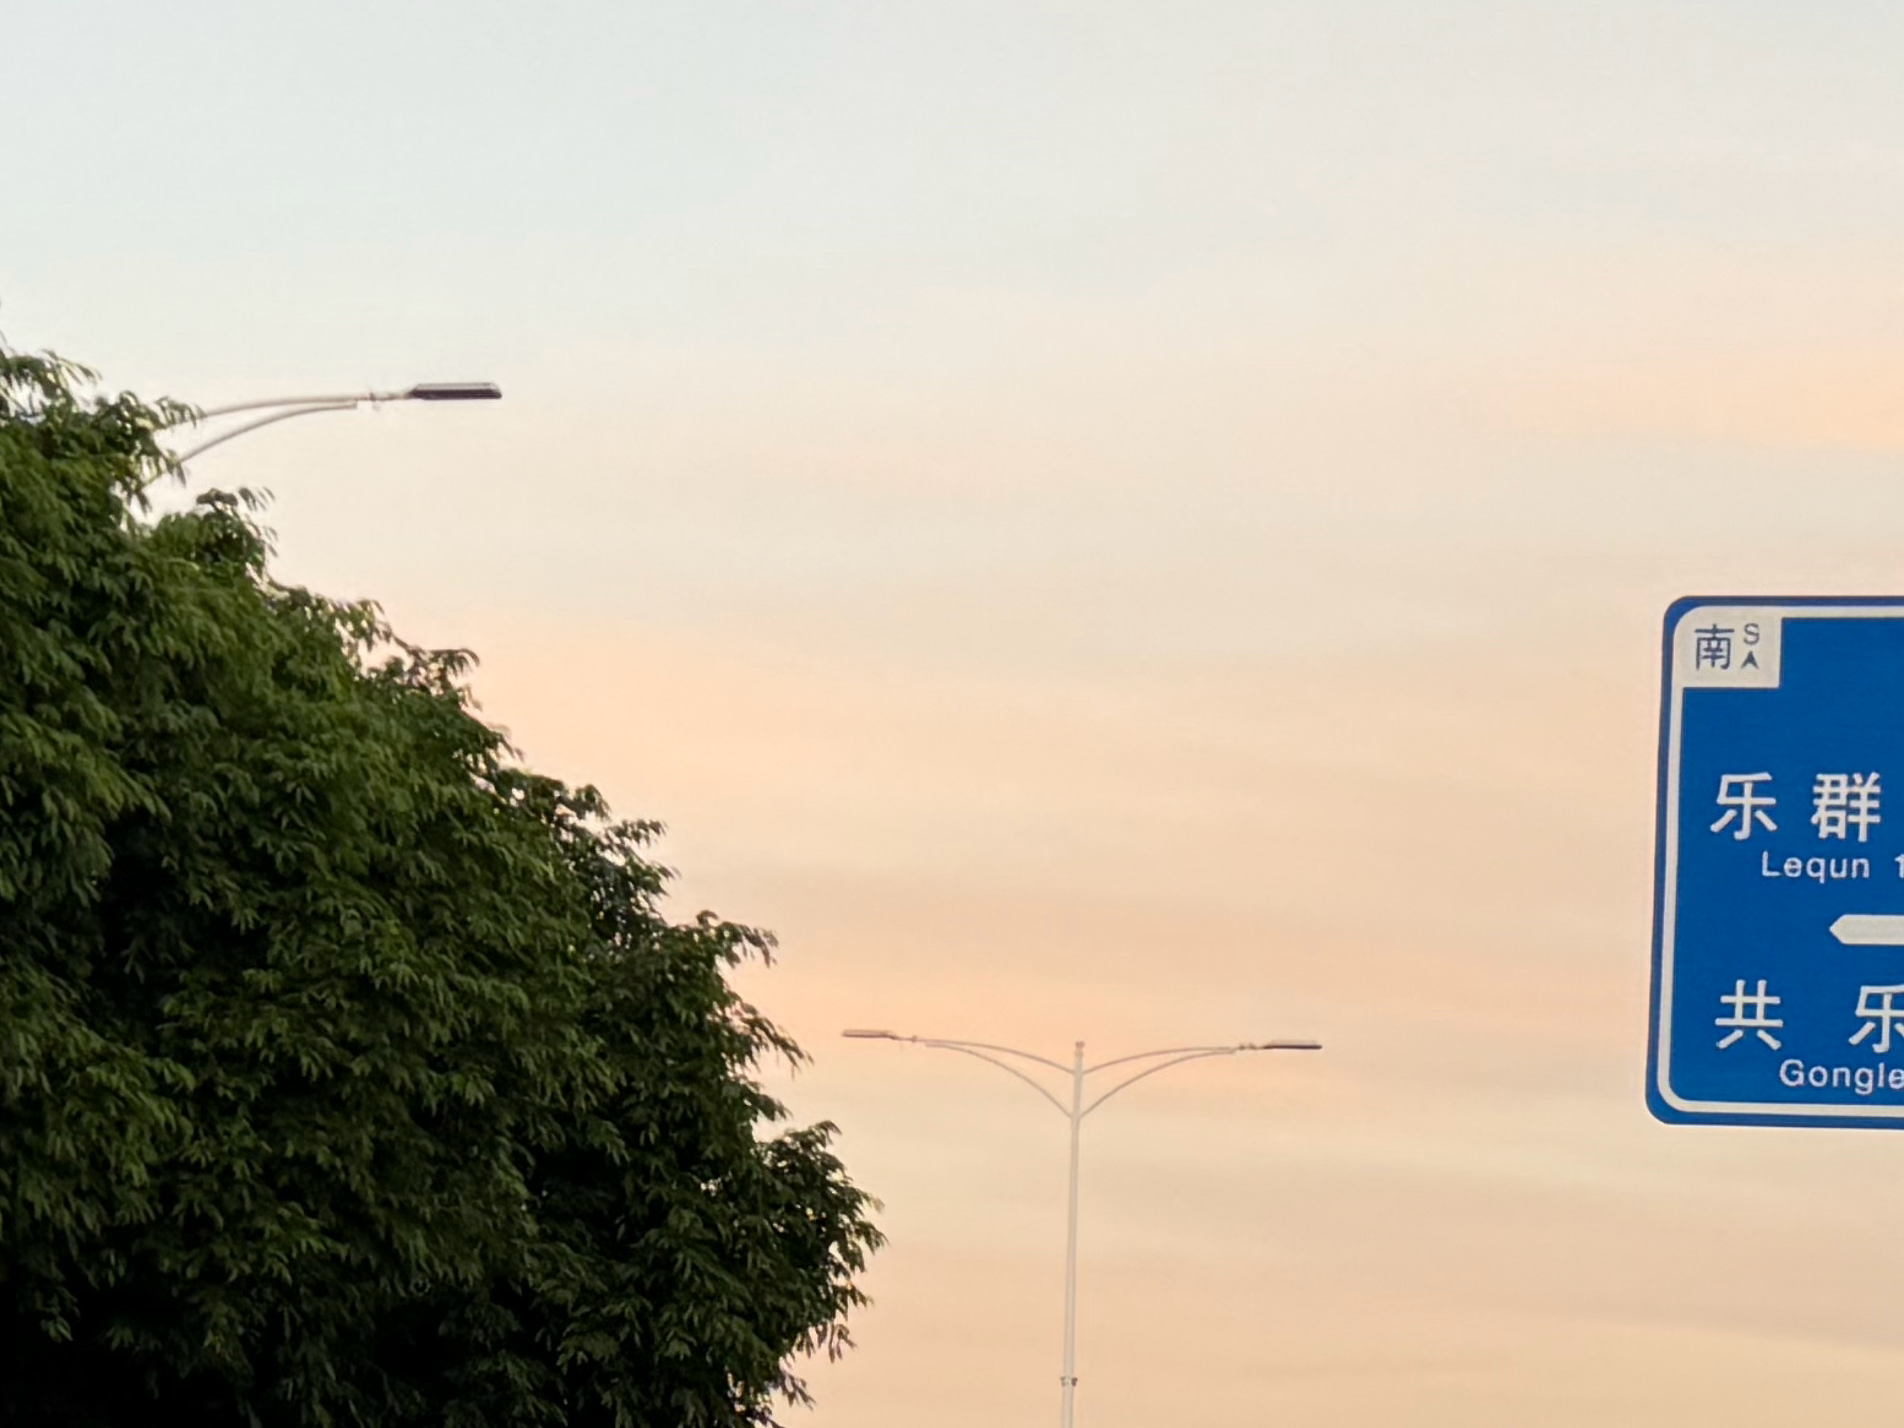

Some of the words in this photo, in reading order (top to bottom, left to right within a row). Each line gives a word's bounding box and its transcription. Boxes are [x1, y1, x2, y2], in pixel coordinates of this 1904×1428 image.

[1694, 623, 1735, 671] 南
[1742, 622, 1761, 646] S
[1761, 851, 1871, 884] Lequn
